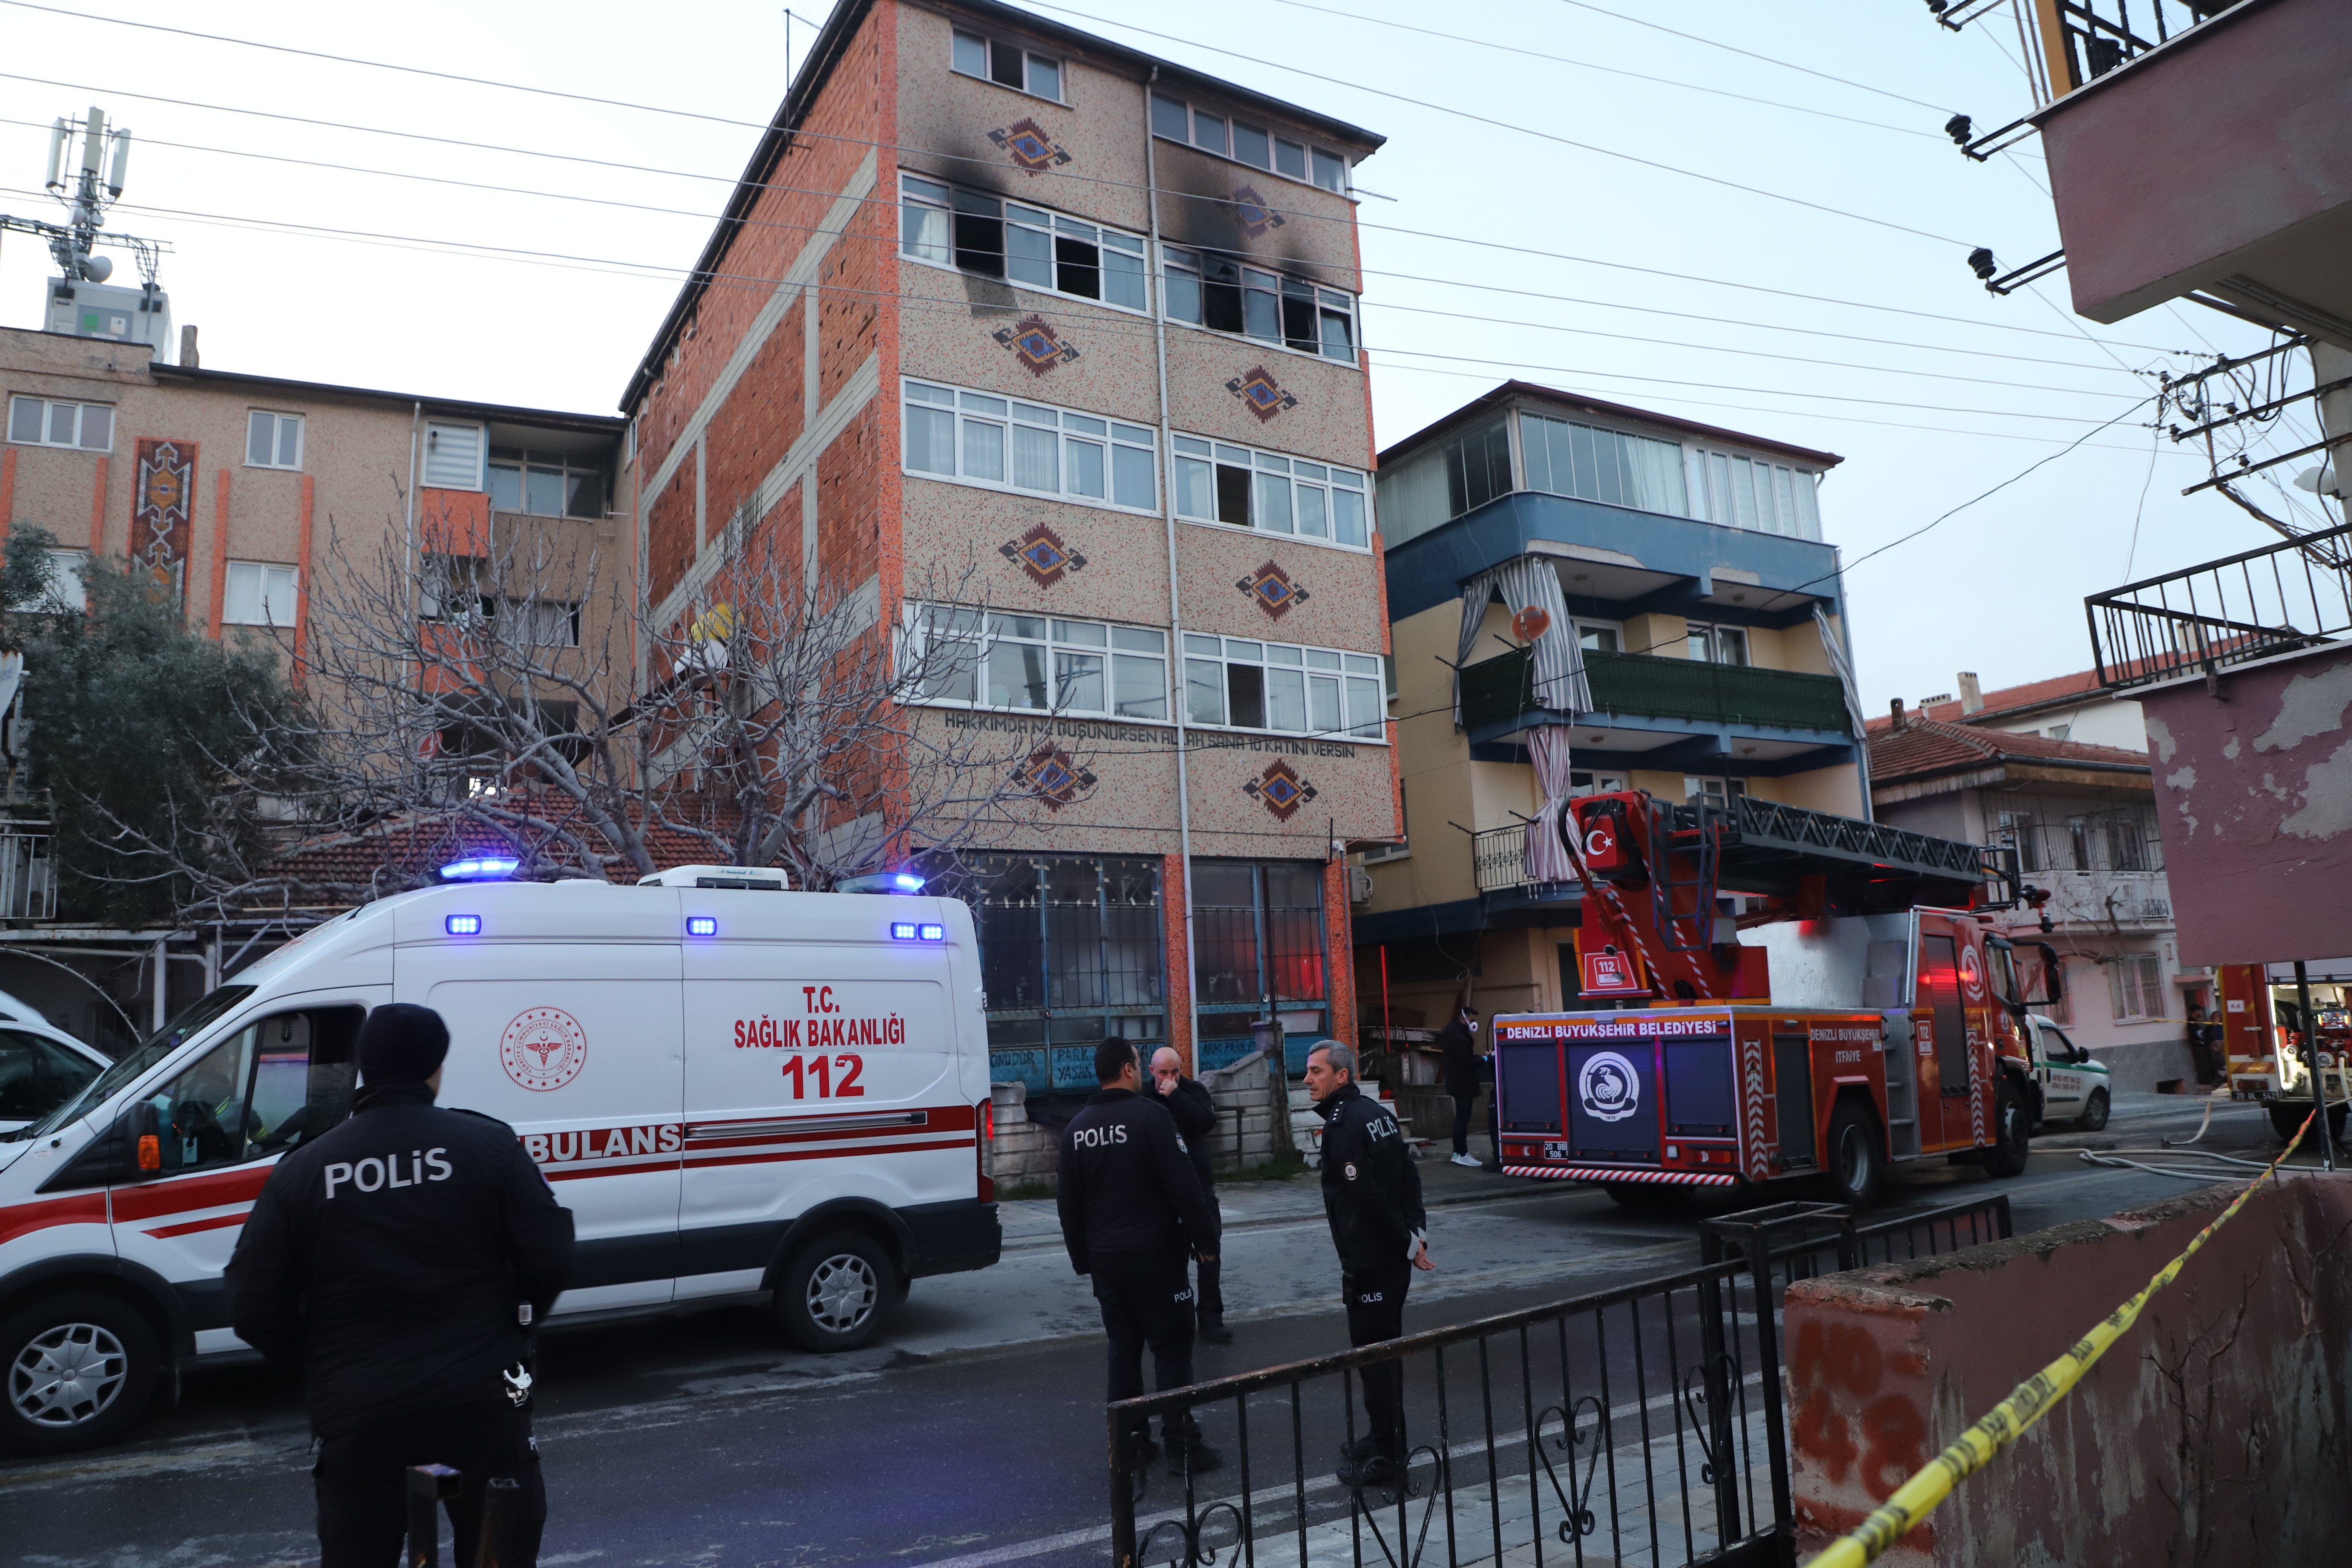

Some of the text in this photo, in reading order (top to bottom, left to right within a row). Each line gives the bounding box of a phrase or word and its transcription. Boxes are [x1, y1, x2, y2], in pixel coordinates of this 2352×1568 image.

[945, 712, 1027, 733] HAKKIMDA
[1162, 729, 1204, 747] ALAH
[1208, 734, 1245, 750] SANA
[1248, 738, 1261, 751] 10
[1599, 961, 1615, 972] 112
[803, 986, 840, 1013] T.C.
[550, 1022, 568, 1038] SAĞLIK
[735, 1012, 905, 1048] SAĞLIK BAKANLIĞI
[1919, 1026, 1929, 1039] 112
[1058, 1047, 1089, 1062] PARK
[782, 1052, 864, 1099] 112
[1058, 1063, 1092, 1081] YASAK
